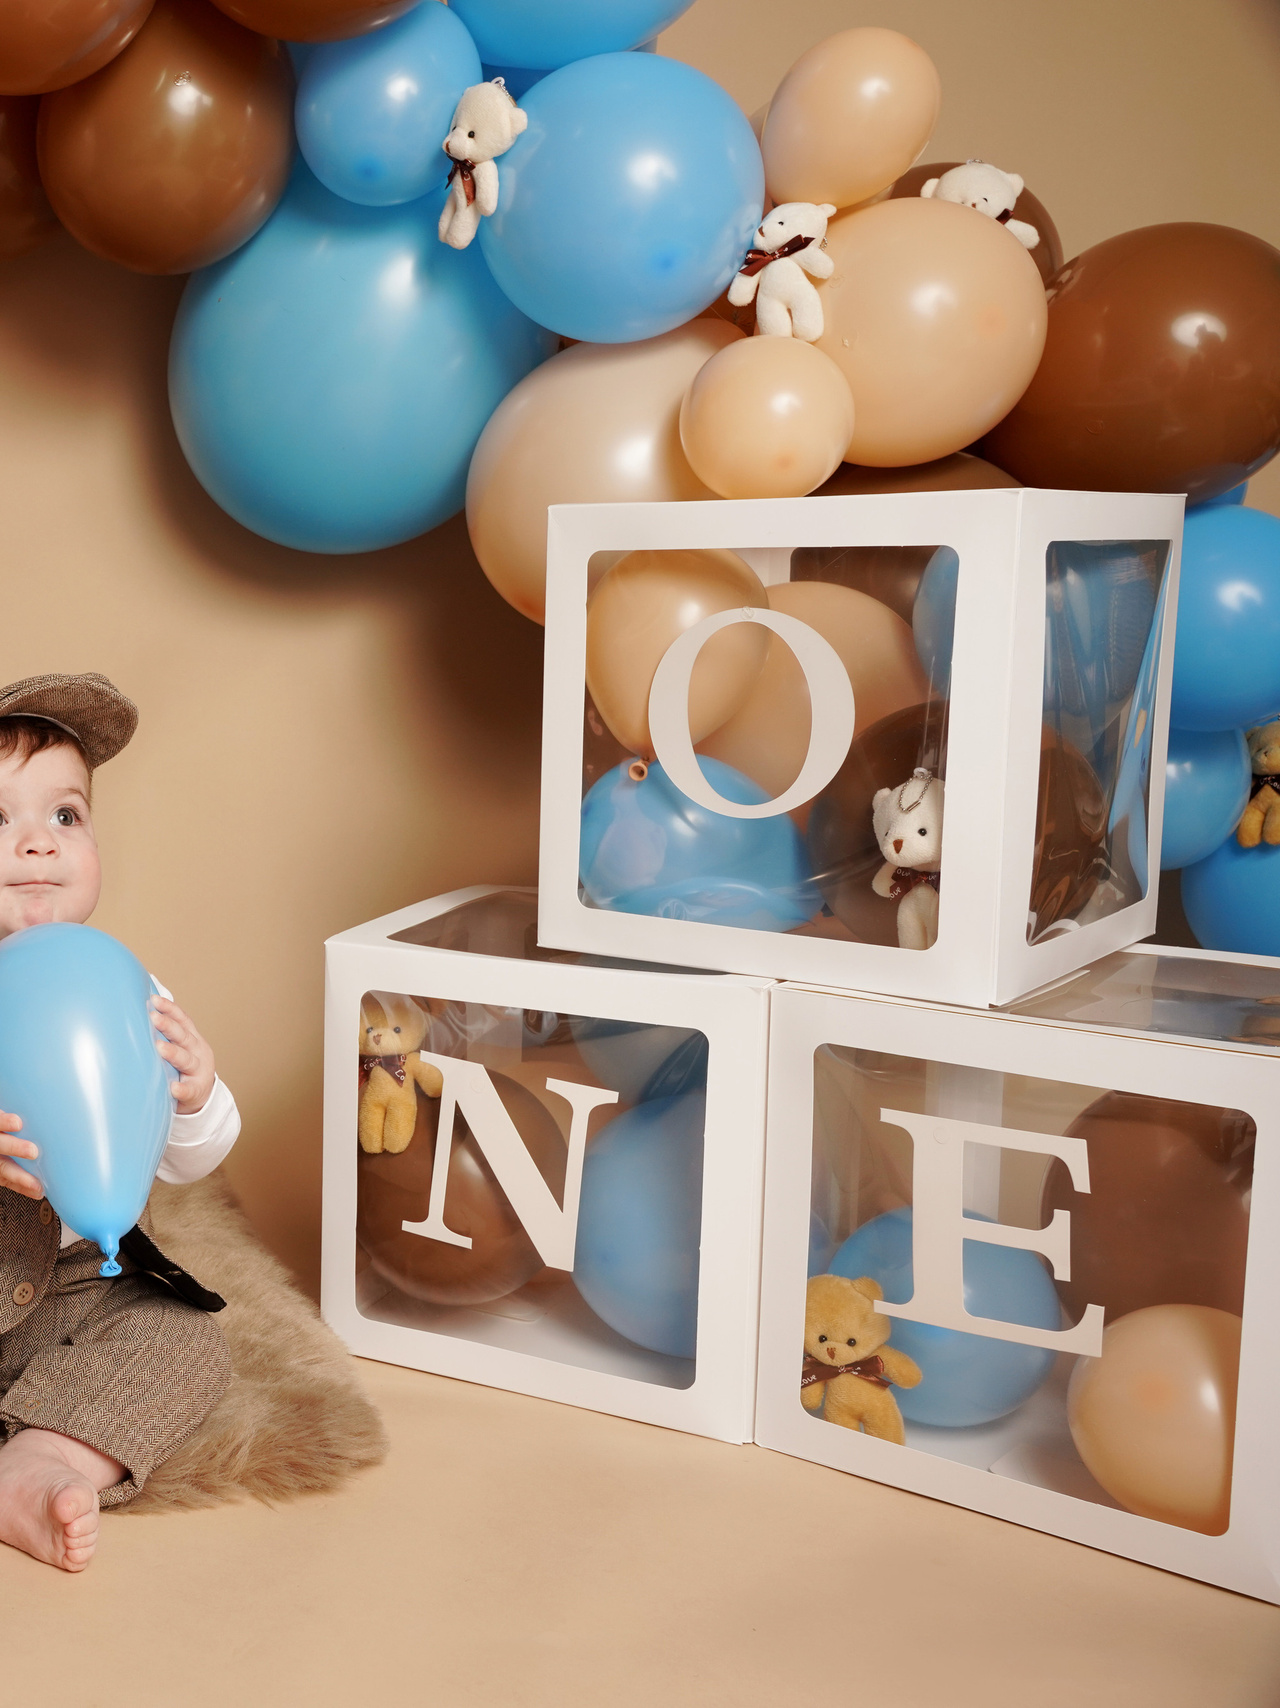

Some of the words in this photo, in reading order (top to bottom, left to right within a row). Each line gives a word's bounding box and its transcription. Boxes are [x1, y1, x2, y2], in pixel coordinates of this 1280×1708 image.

[648, 607, 855, 819] O
[402, 1050, 619, 1272] N
[873, 1107, 1105, 1357] E
